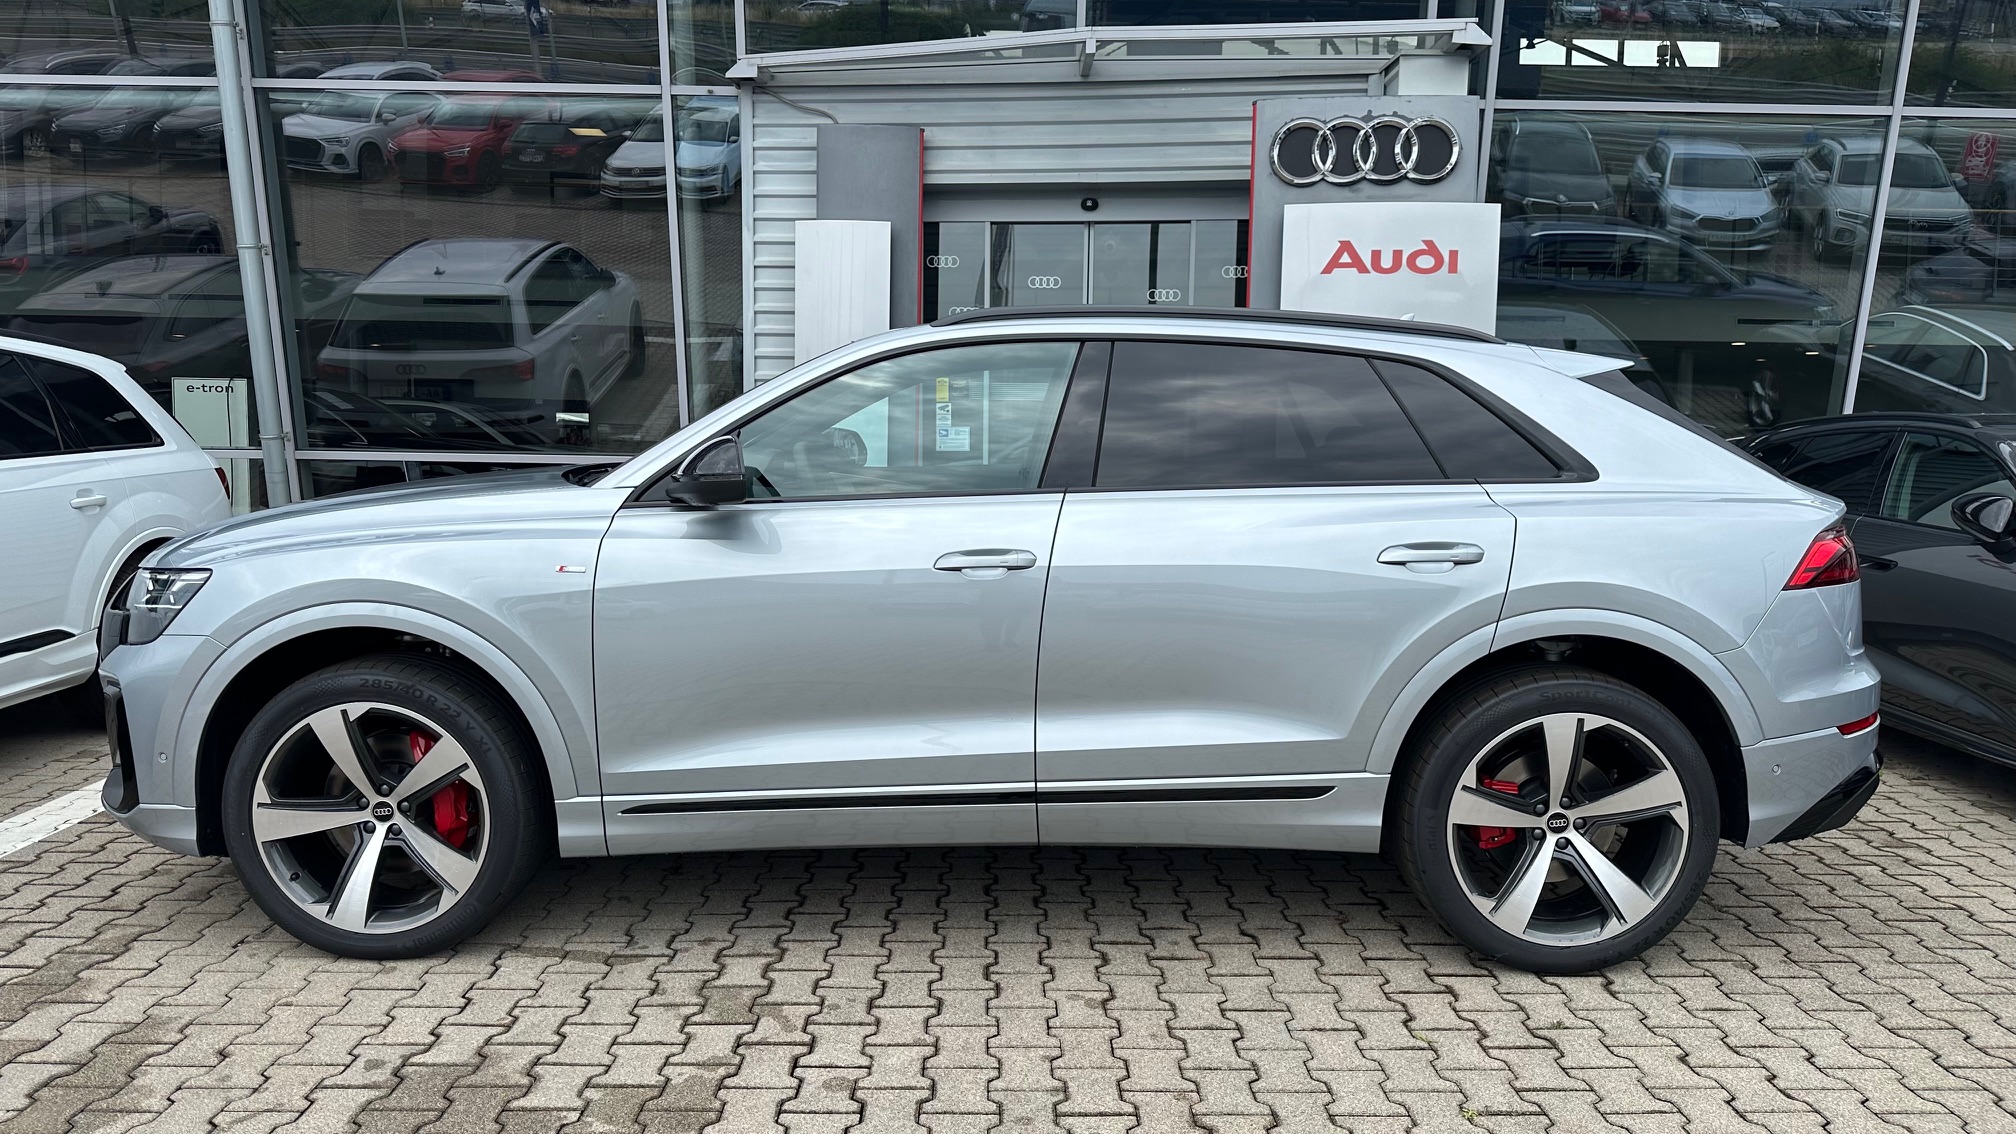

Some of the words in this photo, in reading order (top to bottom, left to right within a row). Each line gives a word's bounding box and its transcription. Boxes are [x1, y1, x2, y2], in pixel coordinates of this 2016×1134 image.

[1320, 239, 1459, 275] Audi
[186, 383, 234, 393] e-tron
[359, 678, 424, 699] 285/40
[426, 693, 439, 707] R
[439, 702, 461, 722] 22
